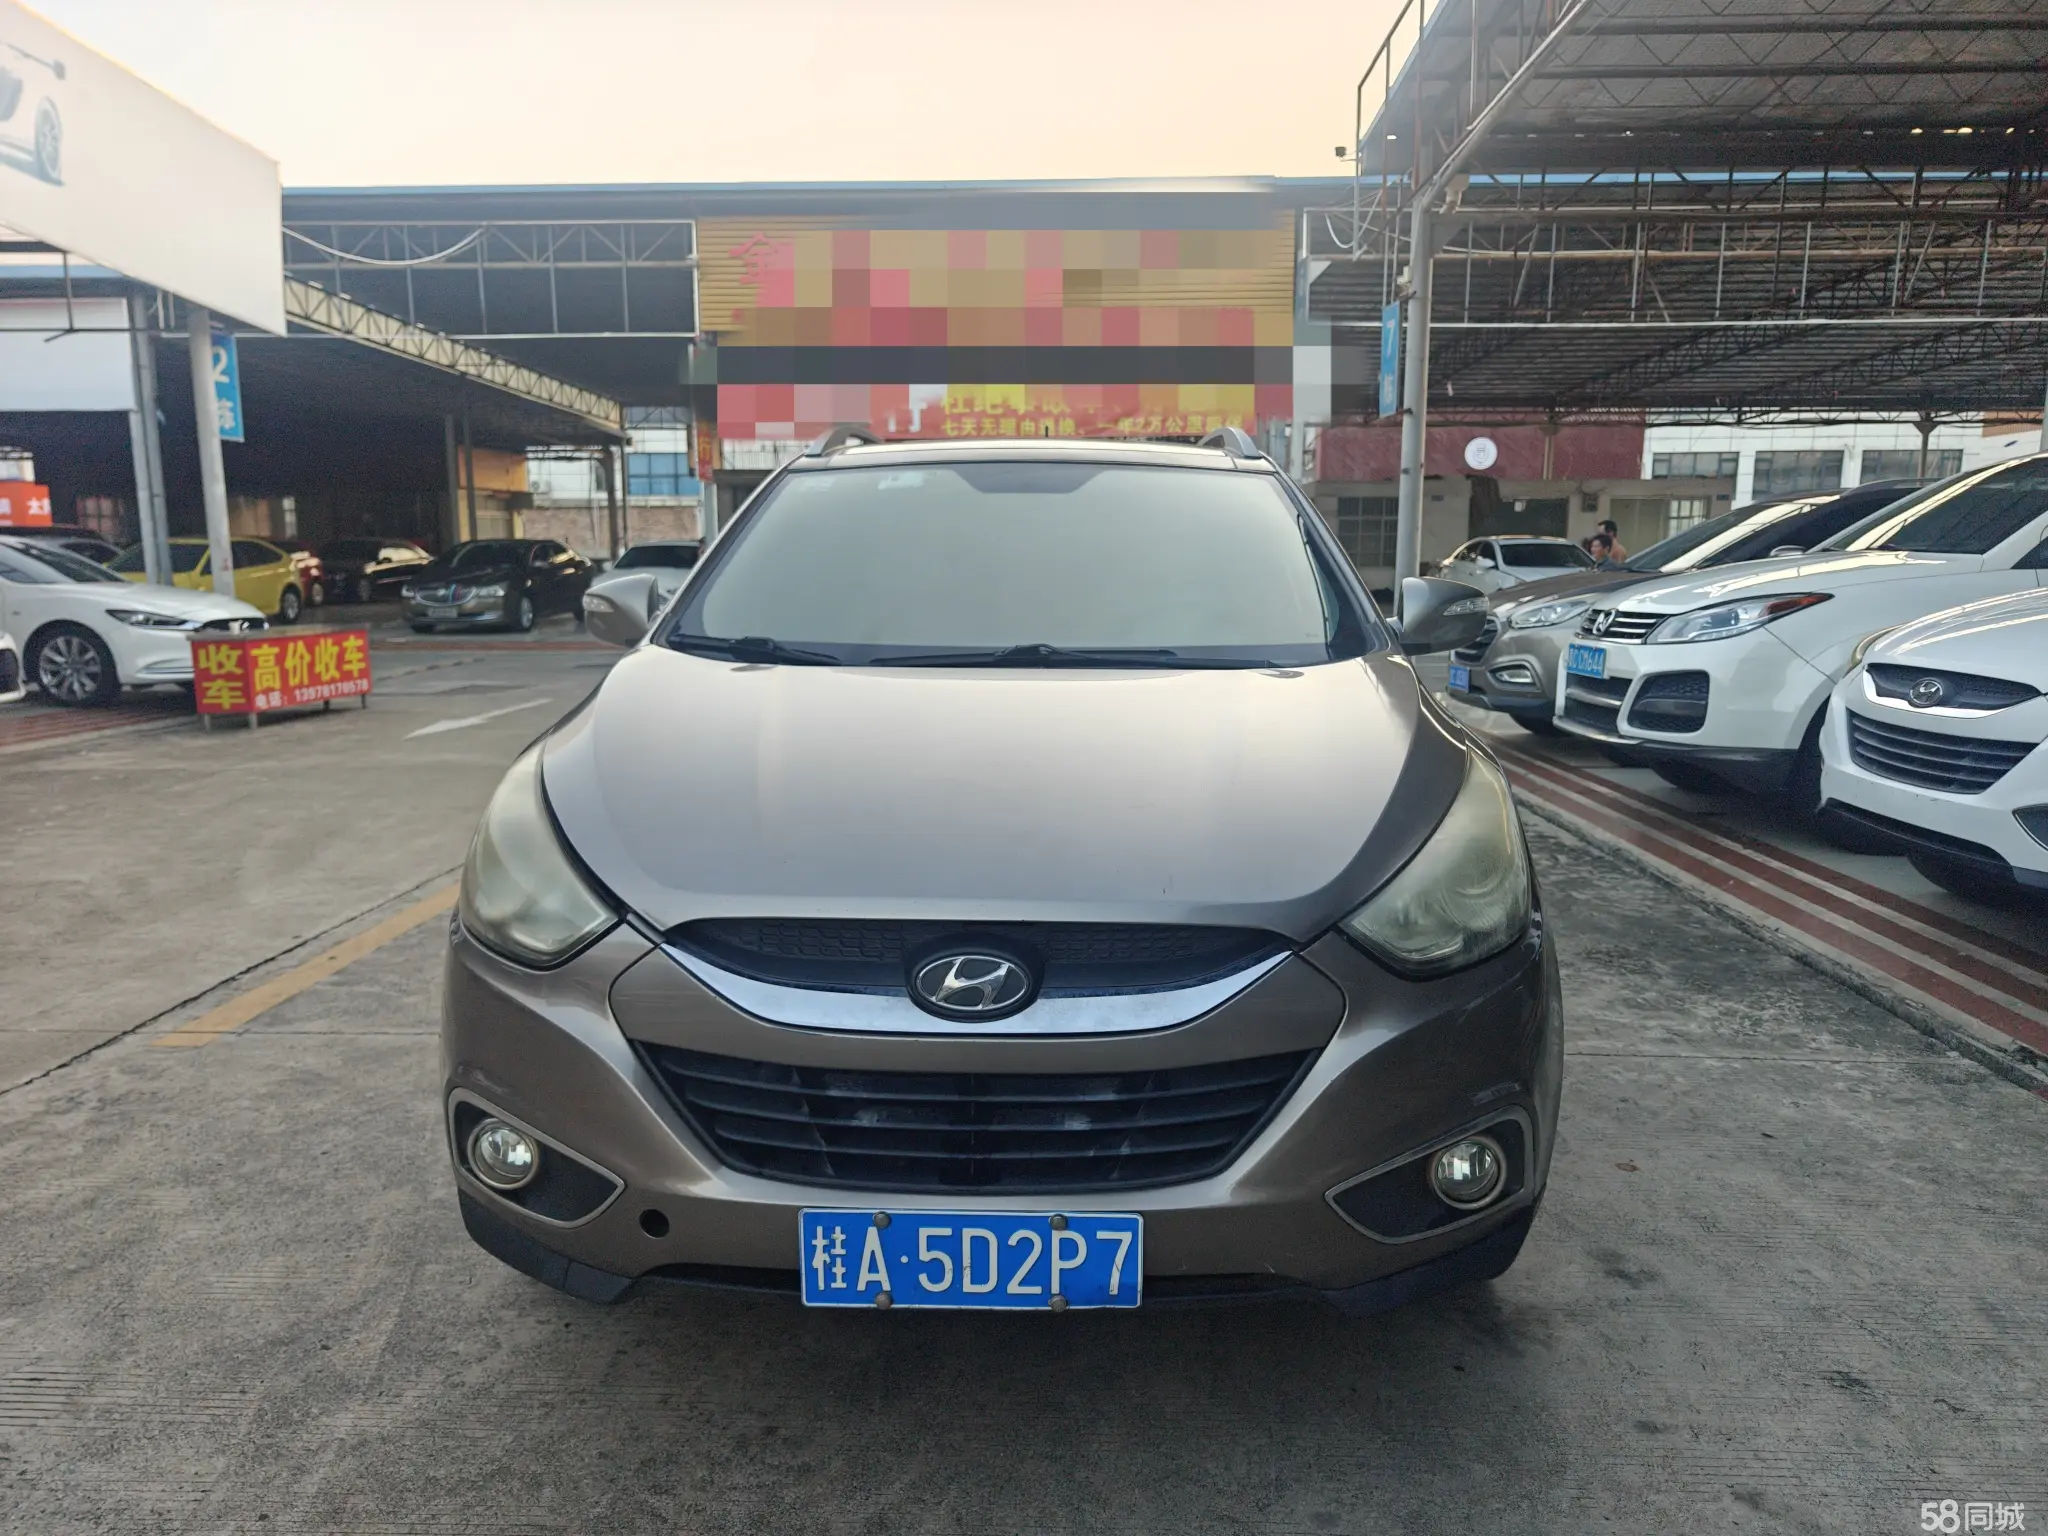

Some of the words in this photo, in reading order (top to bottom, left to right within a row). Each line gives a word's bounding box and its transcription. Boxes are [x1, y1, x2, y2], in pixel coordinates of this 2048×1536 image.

[198, 643, 246, 710] 收车
[251, 635, 366, 692] 高价收车
[811, 1225, 1134, 1295] 桂A·5D2P7
